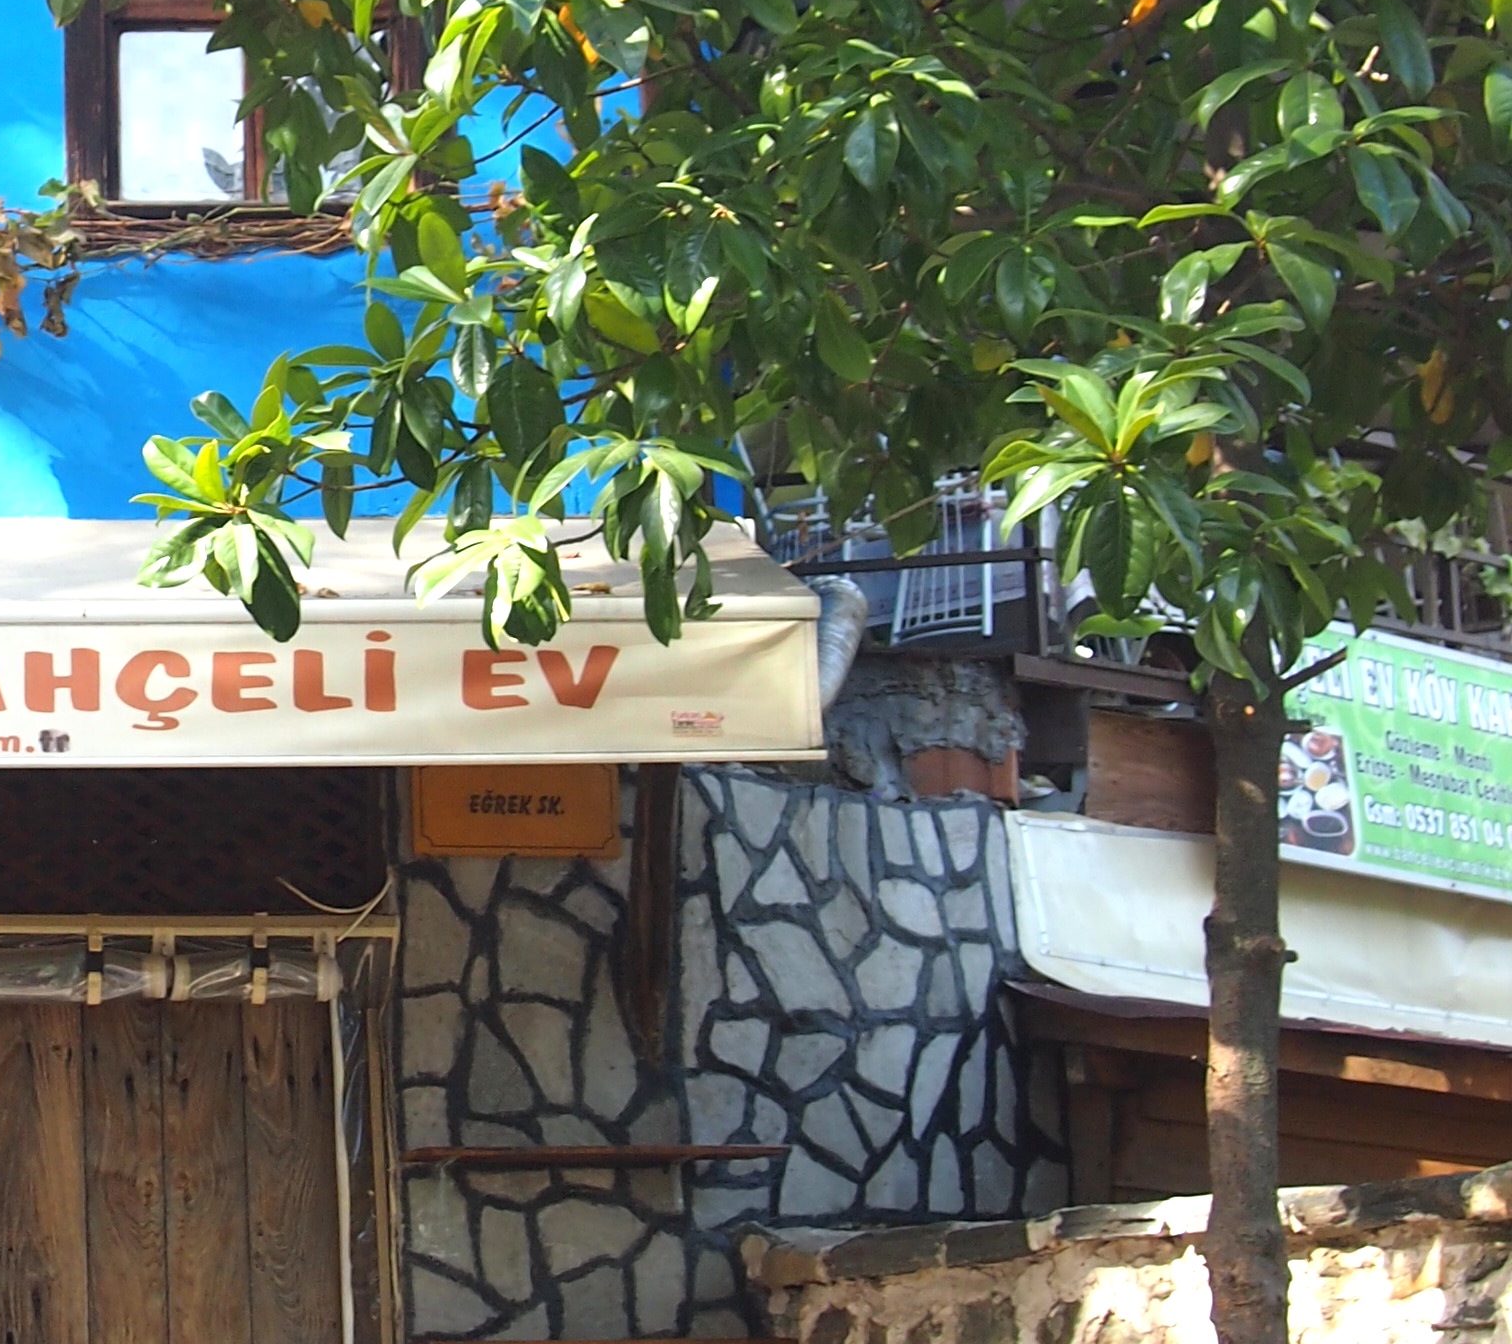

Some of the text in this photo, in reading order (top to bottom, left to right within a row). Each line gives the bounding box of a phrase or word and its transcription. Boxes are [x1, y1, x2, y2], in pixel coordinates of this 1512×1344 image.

[461, 644, 621, 712] EV
[1357, 657, 1395, 709] EV
[1402, 659, 1459, 724] KÖY
[468, 789, 566, 816] EĞREK SK.
[1404, 802, 1445, 837] 0537
[1448, 812, 1479, 843] 851
[1482, 819, 1504, 849] 04
